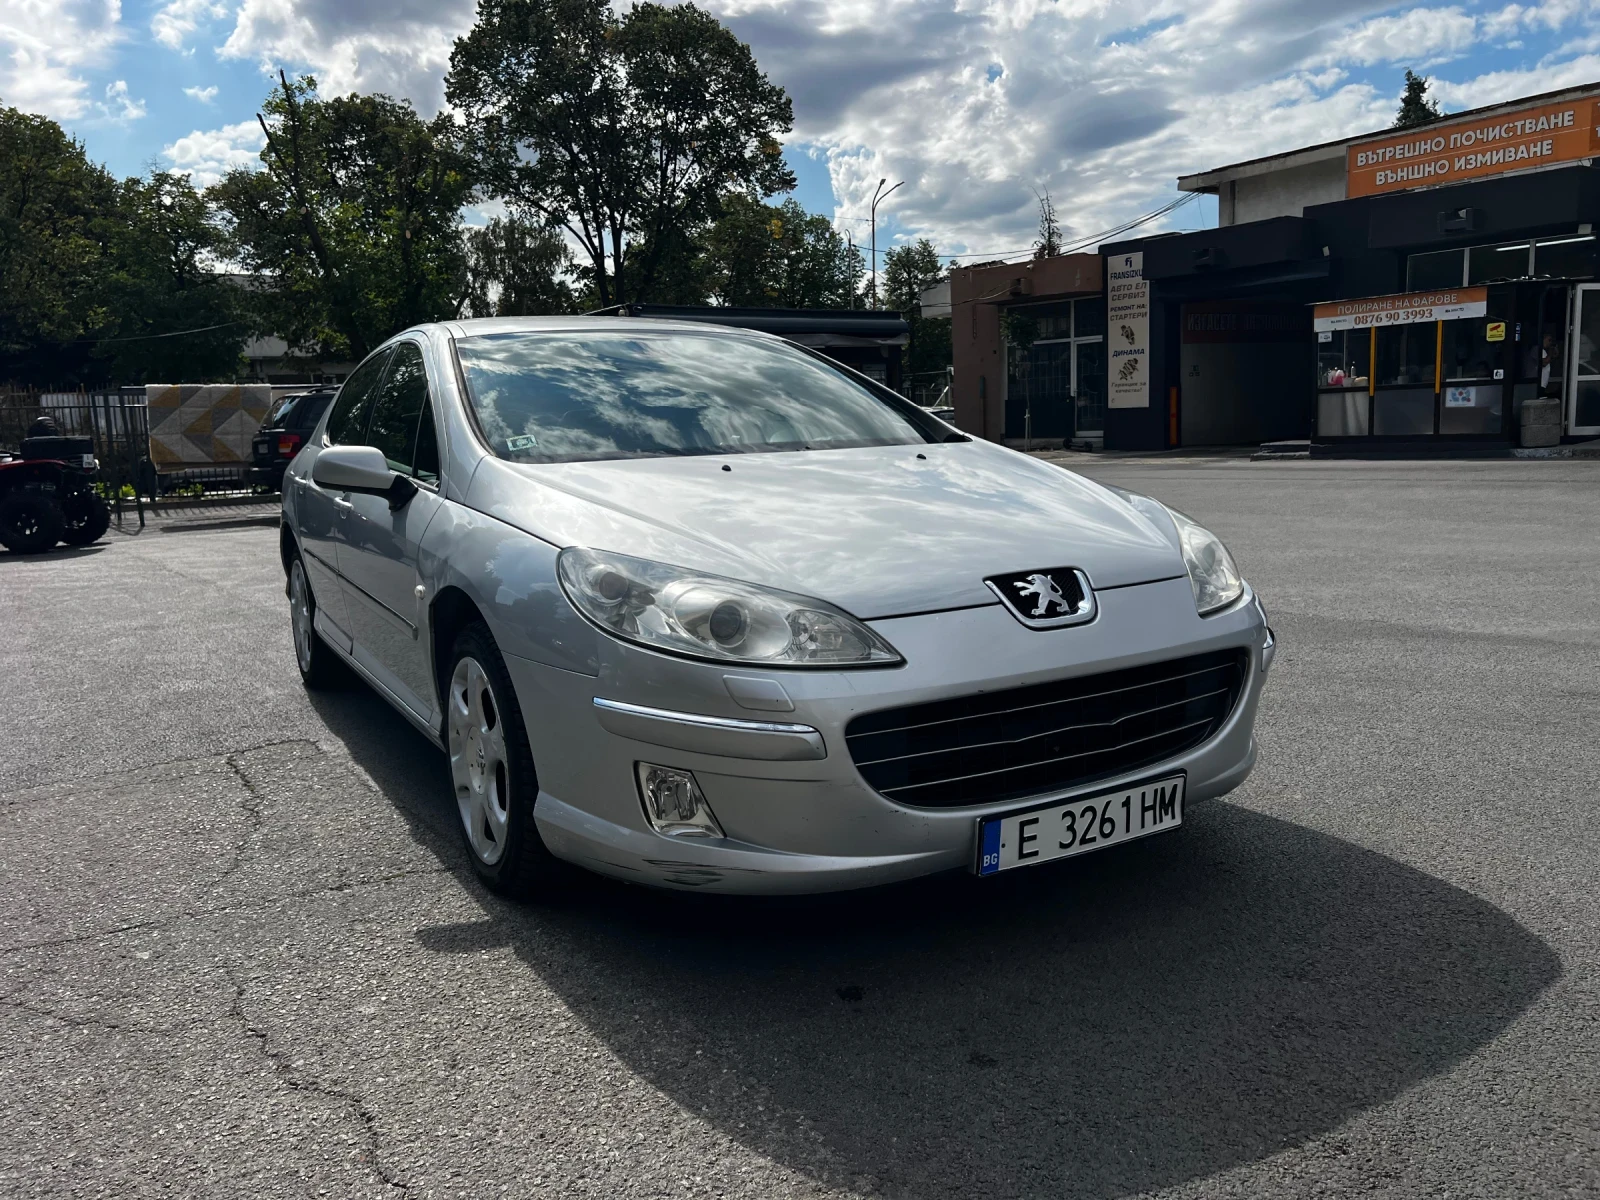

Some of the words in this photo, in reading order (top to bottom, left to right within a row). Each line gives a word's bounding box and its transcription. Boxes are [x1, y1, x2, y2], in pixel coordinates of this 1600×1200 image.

[1357, 136, 1446, 167] ВЪТРЕШНО
[1449, 110, 1575, 149] ПОЧИСТВАНЕ
[1375, 159, 1450, 186] ВЪНШНО
[1454, 139, 1553, 172] ИЗМИВАНЕ
[1110, 283, 1133, 293] АВТО
[1135, 282, 1147, 290] ЕЛ
[1111, 291, 1145, 301] СЕРВИЗ
[1110, 304, 1135, 312] РЕМОНТ
[1337, 301, 1393, 315] ПОЛИРАНЕ
[1395, 298, 1410, 308] НА
[1412, 293, 1458, 307] ФАРОВЕ
[1110, 311, 1148, 321] СТАРТЕРИ
[1354, 311, 1383, 326] 0876
[1385, 310, 1400, 323] 90
[1402, 308, 1433, 321] 3993
[1112, 348, 1145, 358] ДИНАМА
[1018, 817, 1040, 860] E
[1058, 795, 1131, 850] 3261
[1141, 783, 1178, 830] HM
[983, 853, 998, 867] BG
